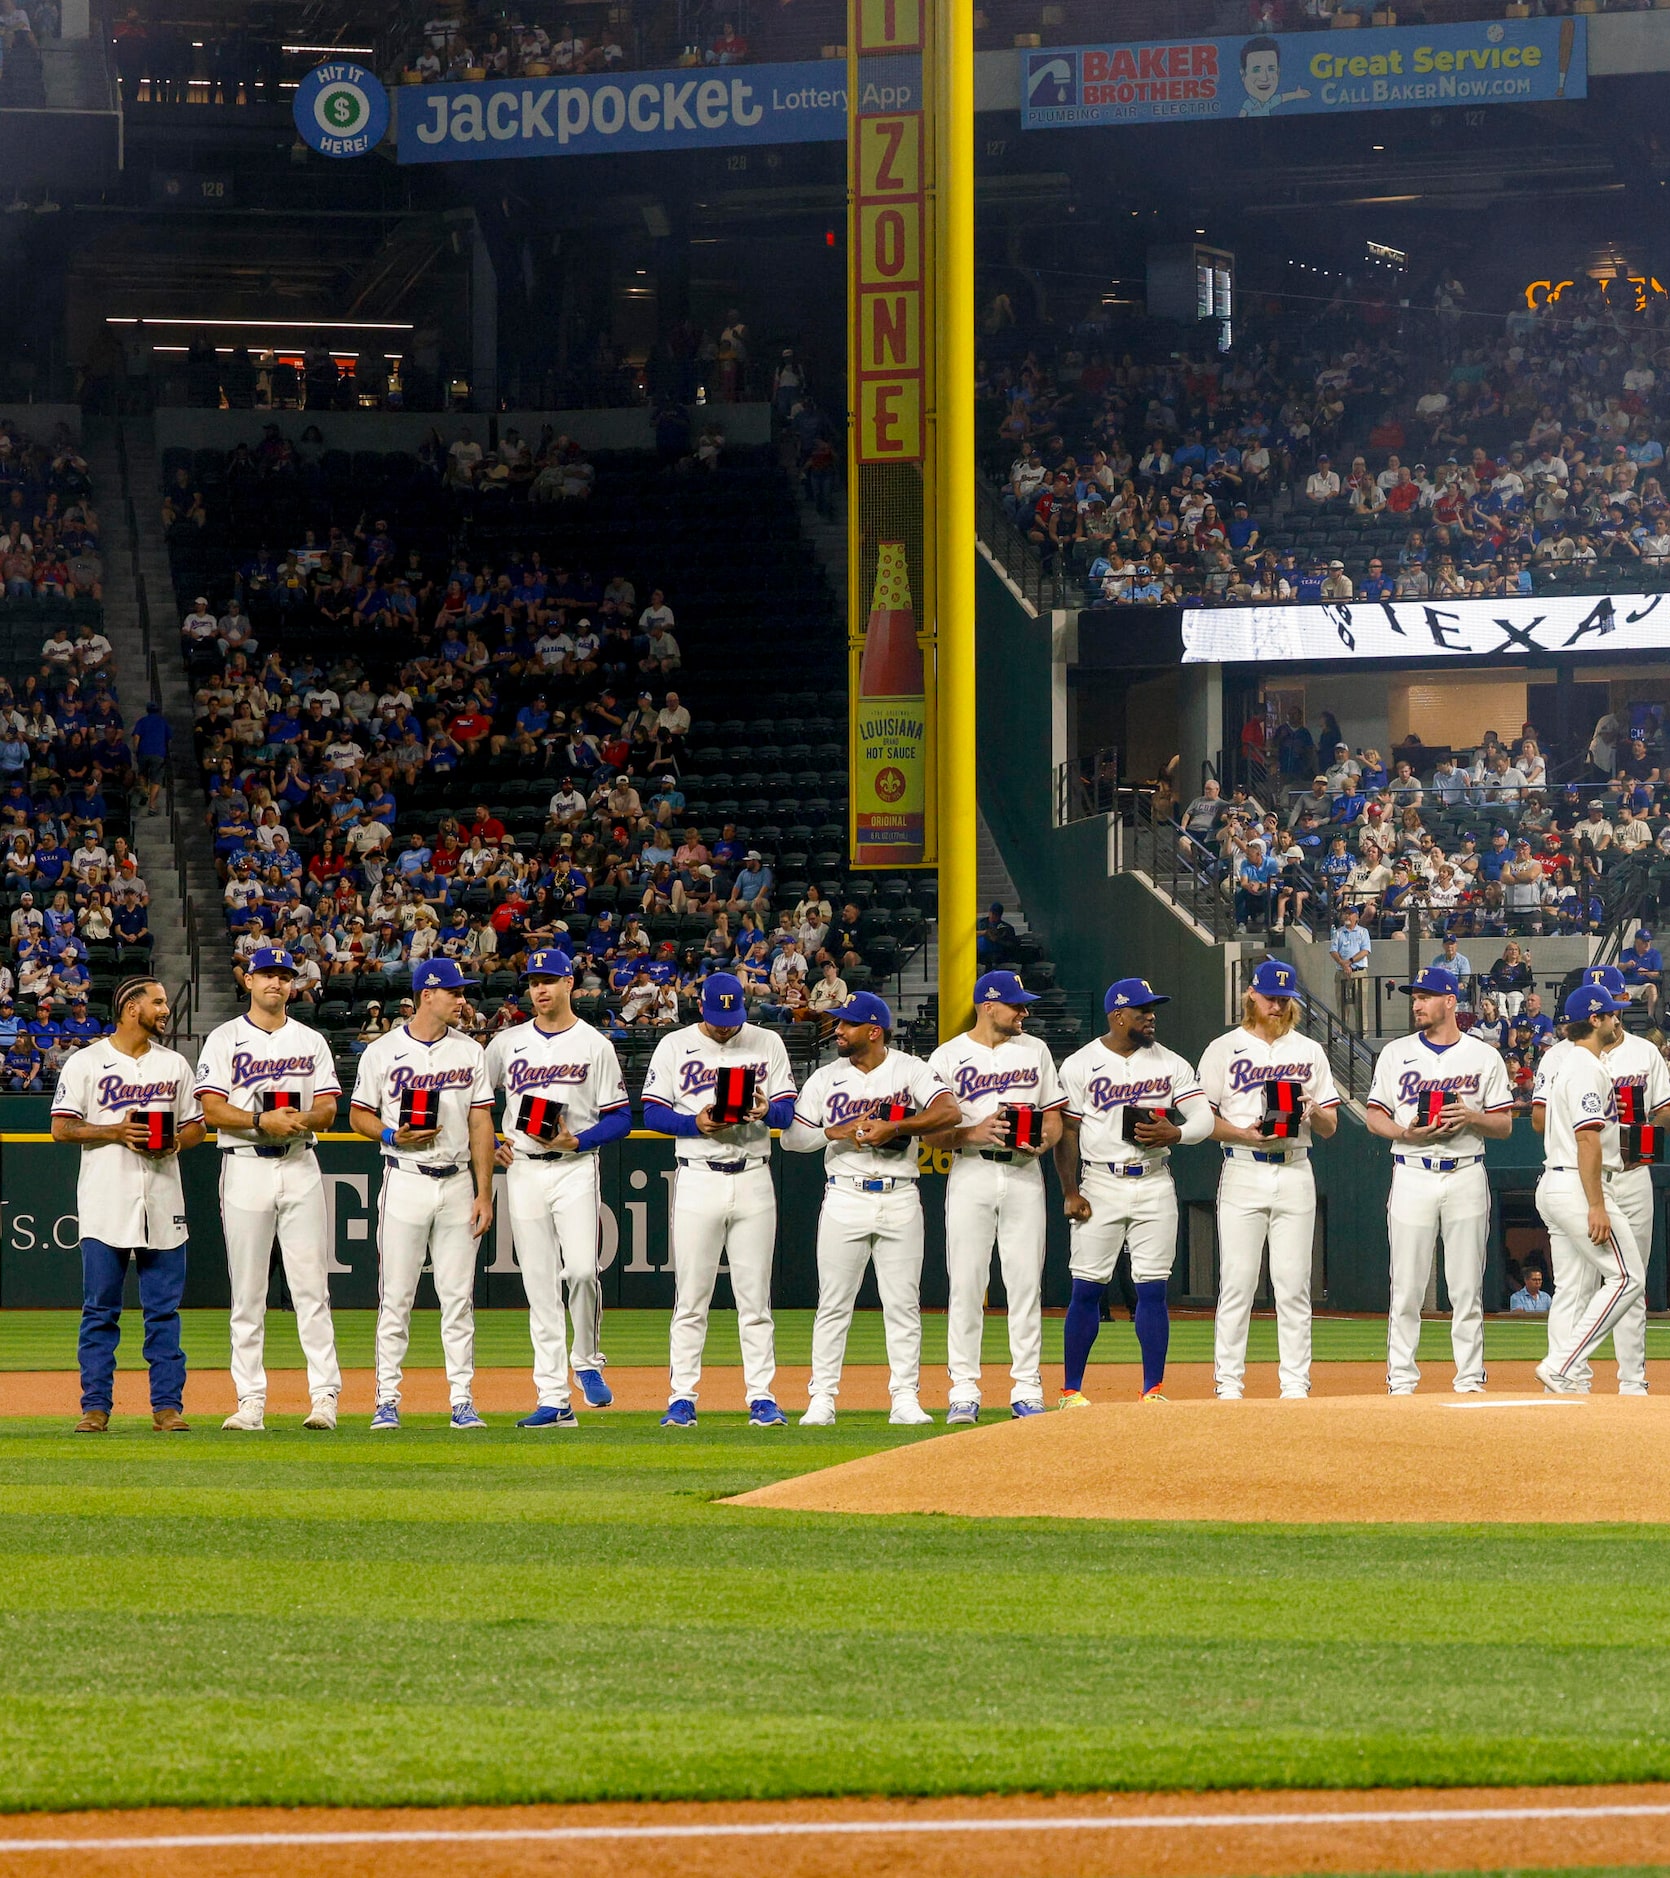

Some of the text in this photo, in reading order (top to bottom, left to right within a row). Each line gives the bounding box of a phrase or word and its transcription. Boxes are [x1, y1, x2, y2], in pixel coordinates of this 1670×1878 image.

[1082, 43, 1219, 83] BAKER
[1310, 45, 1542, 79] Great Service
[316, 65, 364, 84] HIT IT
[772, 88, 848, 112] Lottery
[862, 82, 912, 108] App
[1083, 78, 1217, 105] BROTHERS
[1028, 101, 1221, 122] PLUMBING AIR ELECTRIC
[320, 135, 369, 155] HERE!
[201, 180, 225, 198] 128
[872, 120, 907, 452] ZONE
[859, 718, 924, 741] LOUISIANA
[866, 746, 916, 760] HOT SAUCE
[871, 815, 907, 827] ORIGINAL
[271, 949, 285, 963] T
[533, 952, 547, 967] T
[1276, 970, 1289, 987] T
[1417, 969, 1429, 983] T
[1591, 970, 1604, 985] T
[719, 994, 734, 1009] T
[843, 993, 857, 1008] T
[232, 1052, 316, 1092] Rangers
[507, 1059, 591, 1096] Rangers
[1229, 1059, 1314, 1095] Rangers
[97, 1074, 180, 1113] Rangers
[388, 1066, 476, 1104] Rangers
[954, 1066, 1040, 1104] Rangers
[1088, 1075, 1173, 1114] Rangers
[1398, 1070, 1482, 1106] Rangers
